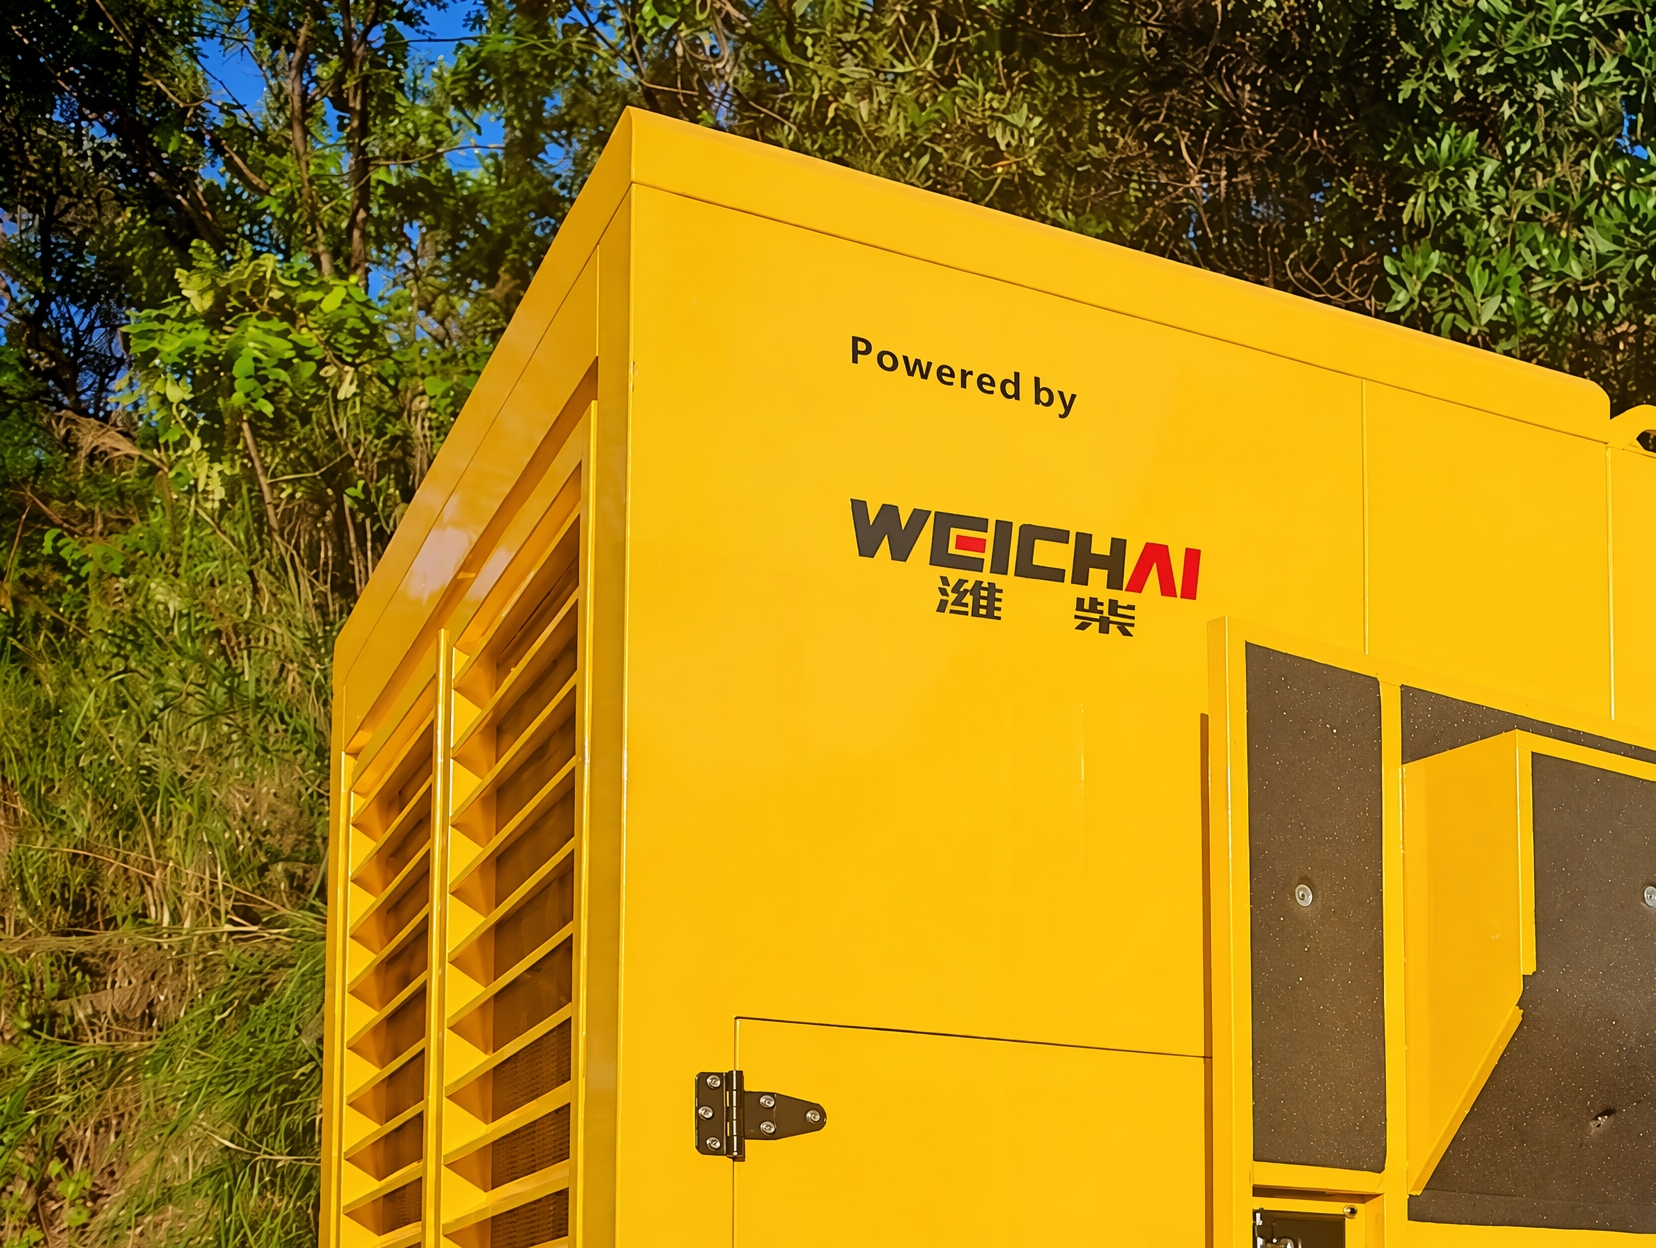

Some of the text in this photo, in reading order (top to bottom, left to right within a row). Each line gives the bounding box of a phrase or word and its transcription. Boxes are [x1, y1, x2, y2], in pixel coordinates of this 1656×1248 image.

[850, 335, 1078, 419] Powered by
[850, 498, 1202, 601] WEICHAI
